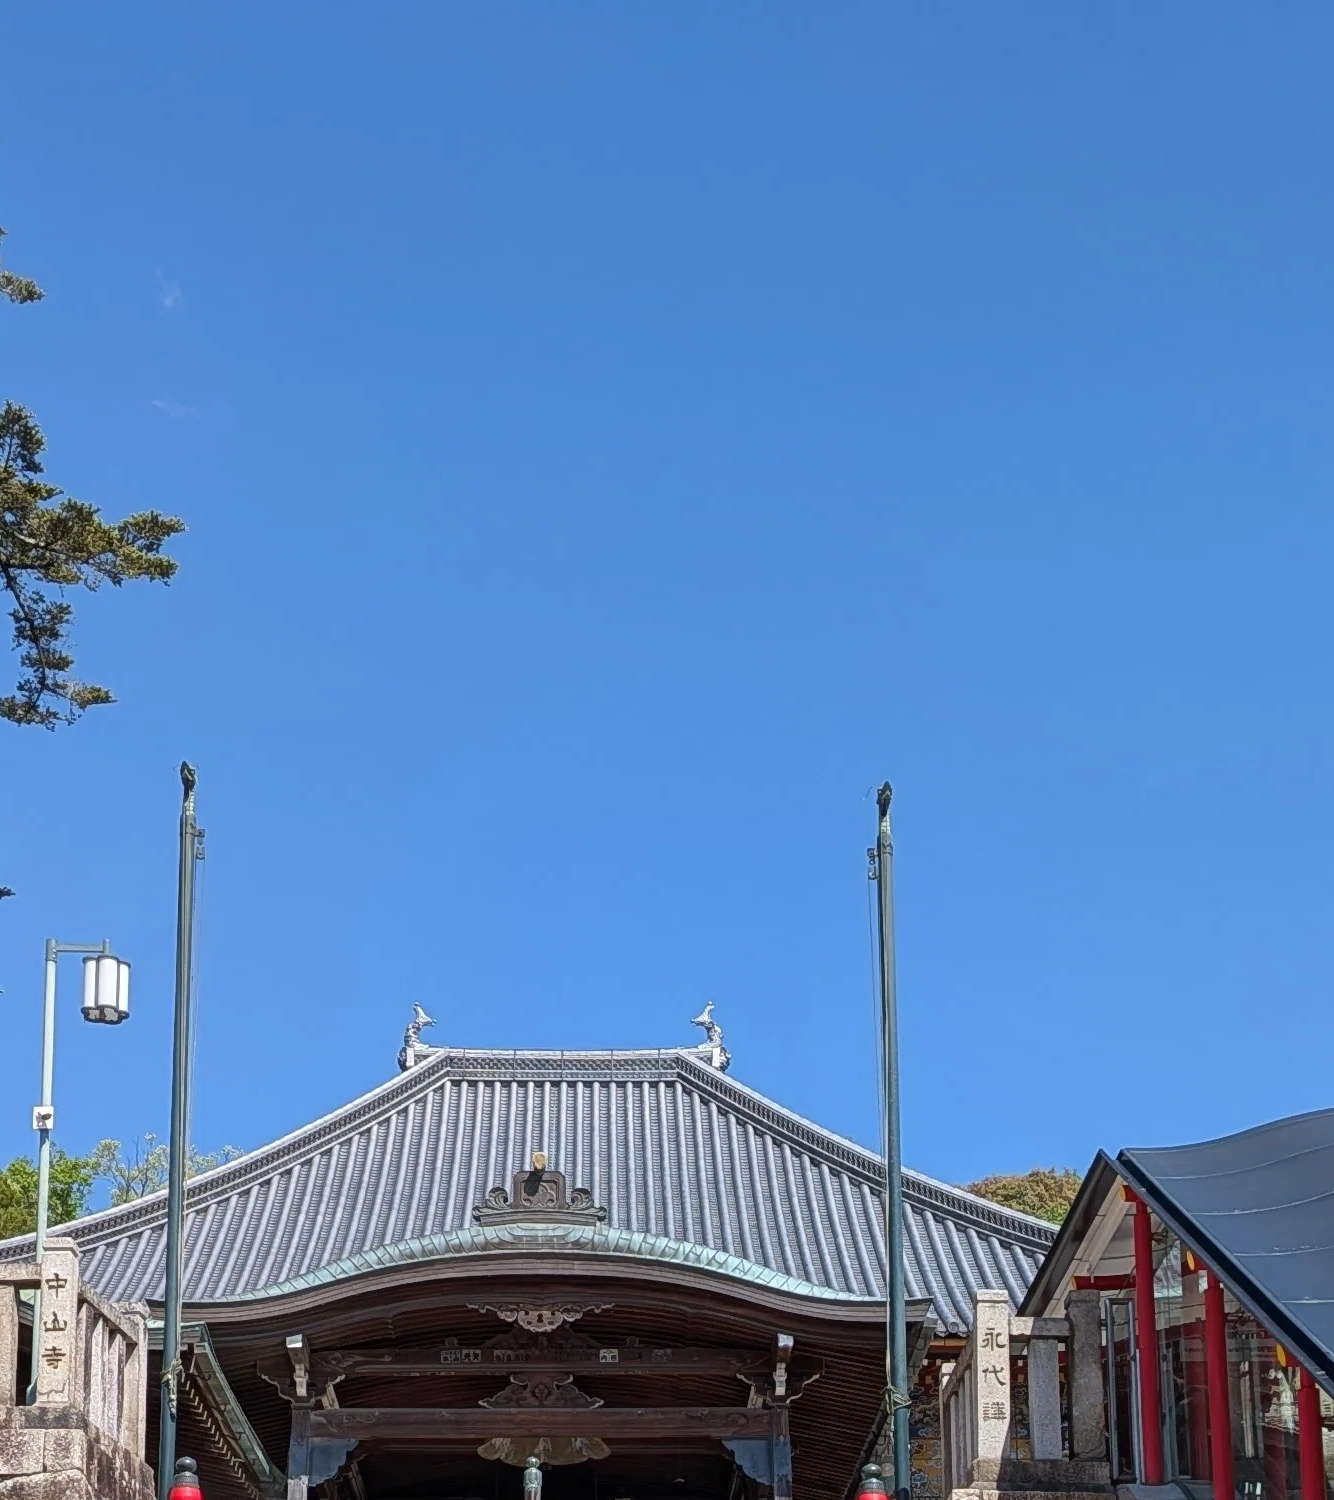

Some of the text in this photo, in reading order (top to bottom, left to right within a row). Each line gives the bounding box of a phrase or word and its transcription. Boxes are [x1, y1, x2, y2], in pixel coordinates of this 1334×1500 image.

[41, 1272, 68, 1370] 中山寺
[980, 1327, 1007, 1424] 永代講
